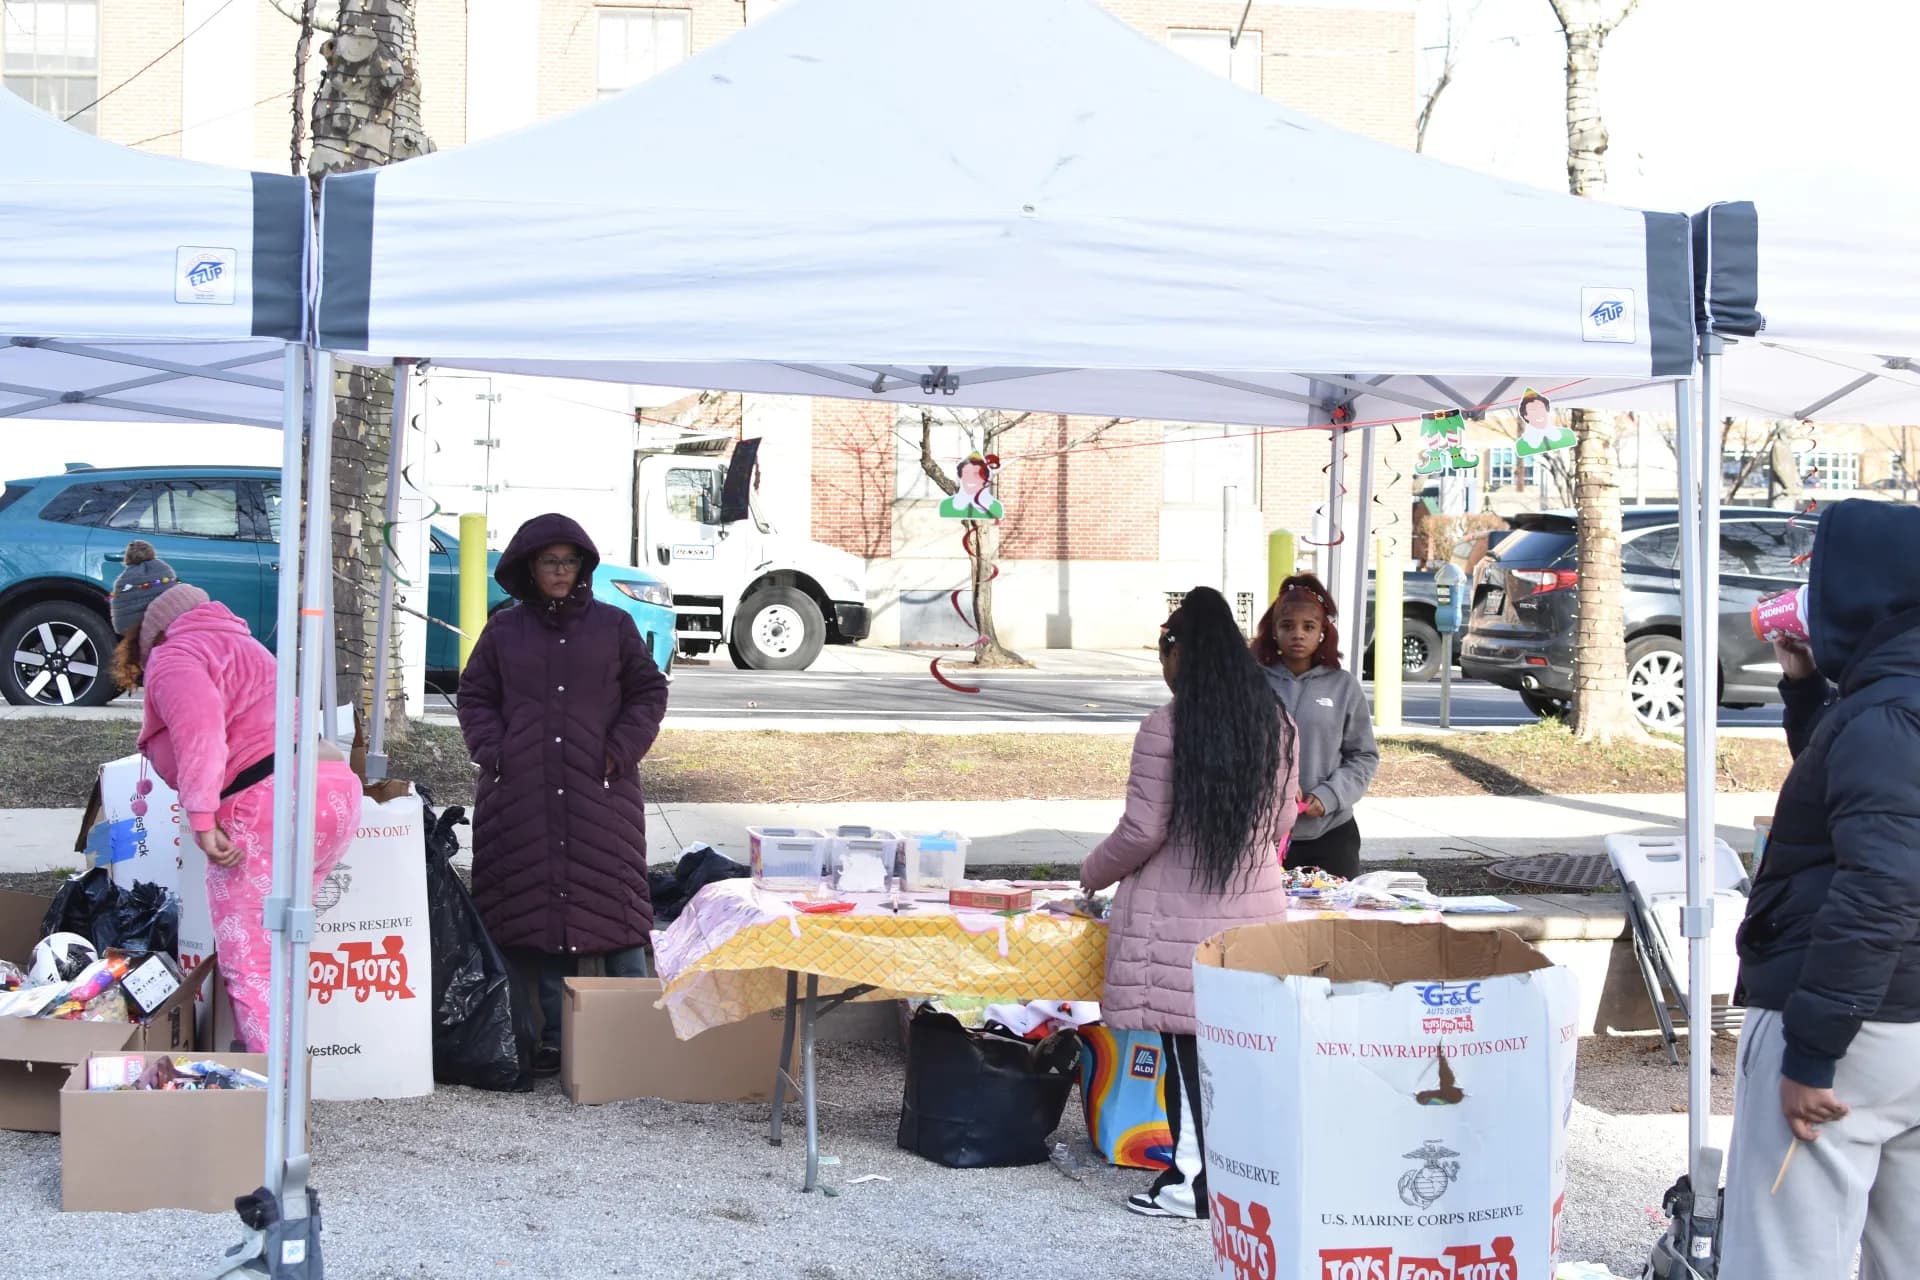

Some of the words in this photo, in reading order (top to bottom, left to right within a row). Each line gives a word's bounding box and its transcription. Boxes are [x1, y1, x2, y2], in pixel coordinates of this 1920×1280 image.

[356, 826, 381, 839] OYS
[383, 824, 412, 838] ONLY
[359, 916, 413, 931] RESERVE
[309, 960, 339, 985] OR
[350, 957, 400, 986] TOTS
[1424, 981, 1481, 1006] G&C
[1426, 1007, 1445, 1015] AUTO
[1446, 1006, 1472, 1015] SERVICE
[1205, 1023, 1235, 1047] TOYS
[1236, 1031, 1277, 1053] ONLY
[1459, 1041, 1493, 1057] TOYS
[1494, 1036, 1529, 1051] ONLY
[1134, 1064, 1154, 1074] ALDI
[1225, 1157, 1280, 1186] RESERVE
[1321, 1213, 1348, 1225] U.S.
[1351, 1214, 1414, 1227] MARINE
[1417, 1211, 1465, 1227] CORPS
[1468, 1204, 1524, 1222] RESERVE
[1227, 1225, 1269, 1280] TOTS
